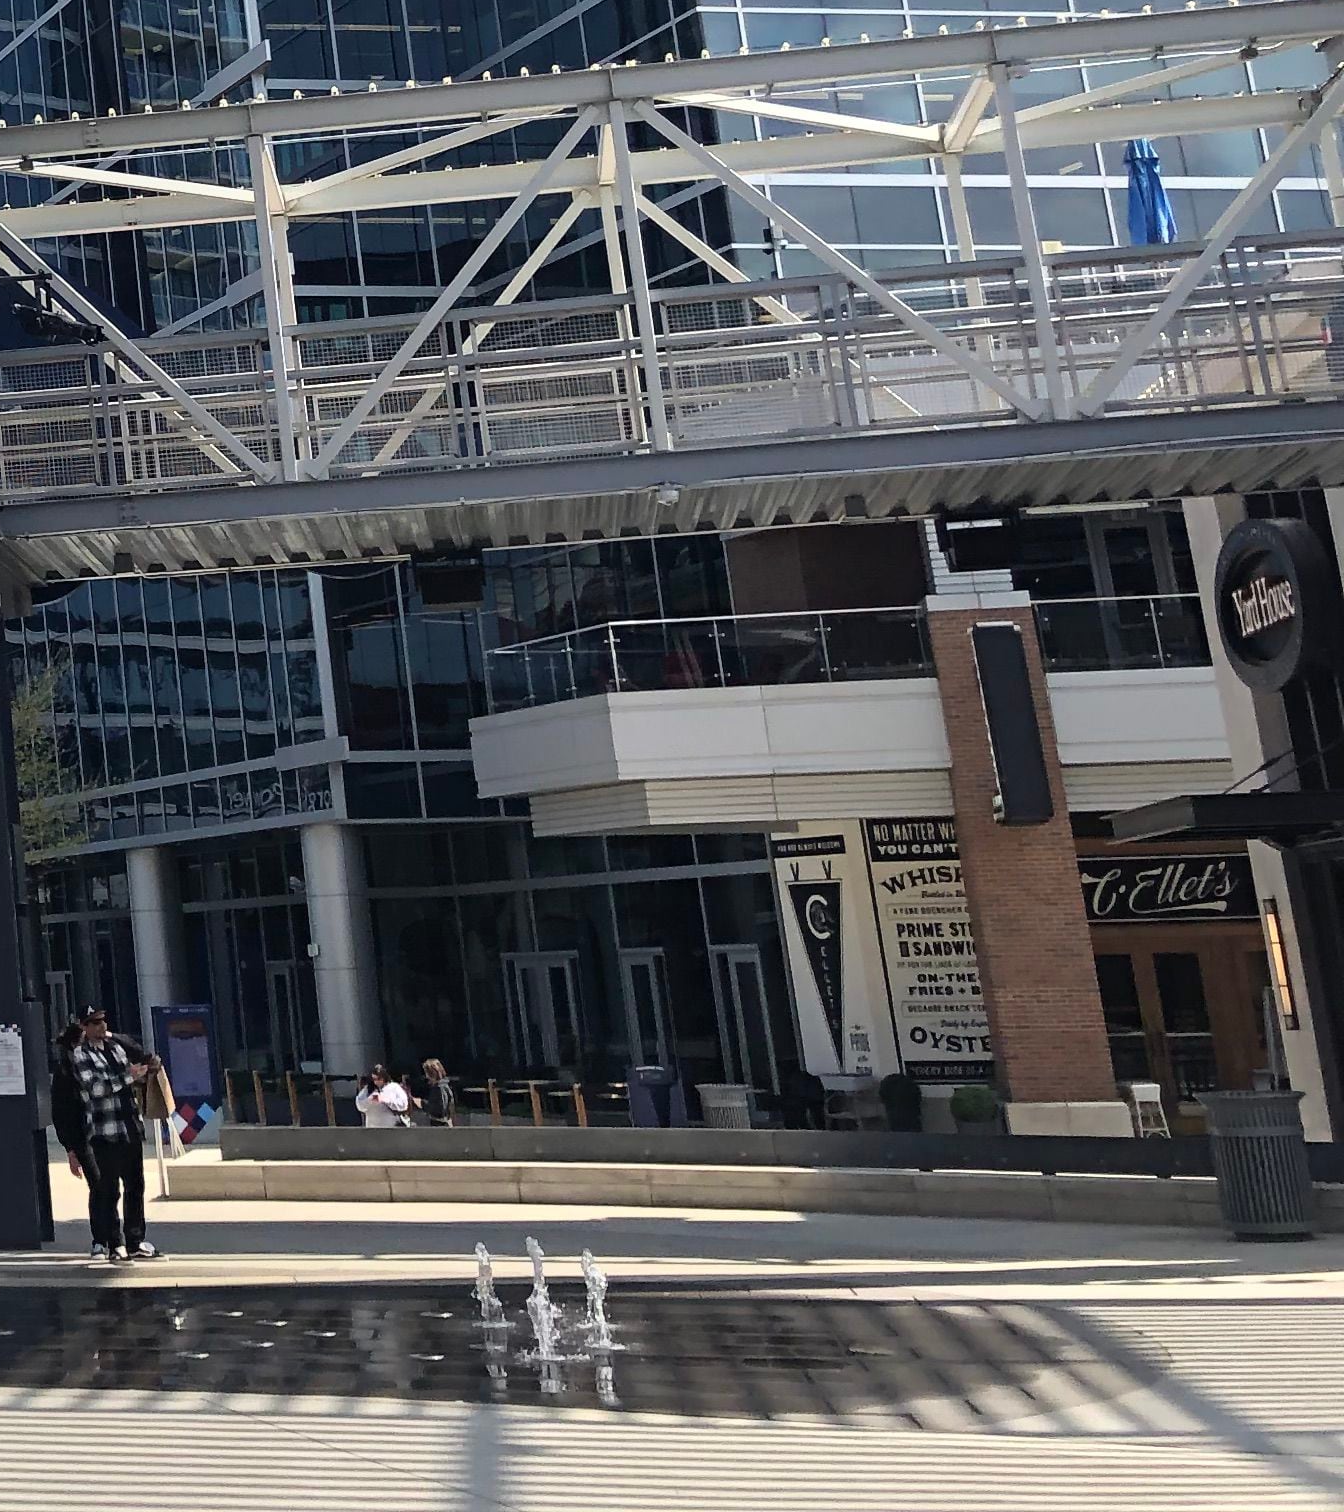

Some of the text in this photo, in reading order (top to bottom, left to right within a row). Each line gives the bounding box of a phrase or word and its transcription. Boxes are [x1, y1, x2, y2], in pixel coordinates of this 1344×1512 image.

[872, 824, 890, 842] NO
[892, 822, 936, 841] MATTER
[877, 843, 959, 856] YOU CAN'T
[1128, 861, 1240, 915] Ellet's
[805, 894, 831, 940] C
[896, 922, 945, 938] PRIME
[908, 986, 954, 996] FRIES
